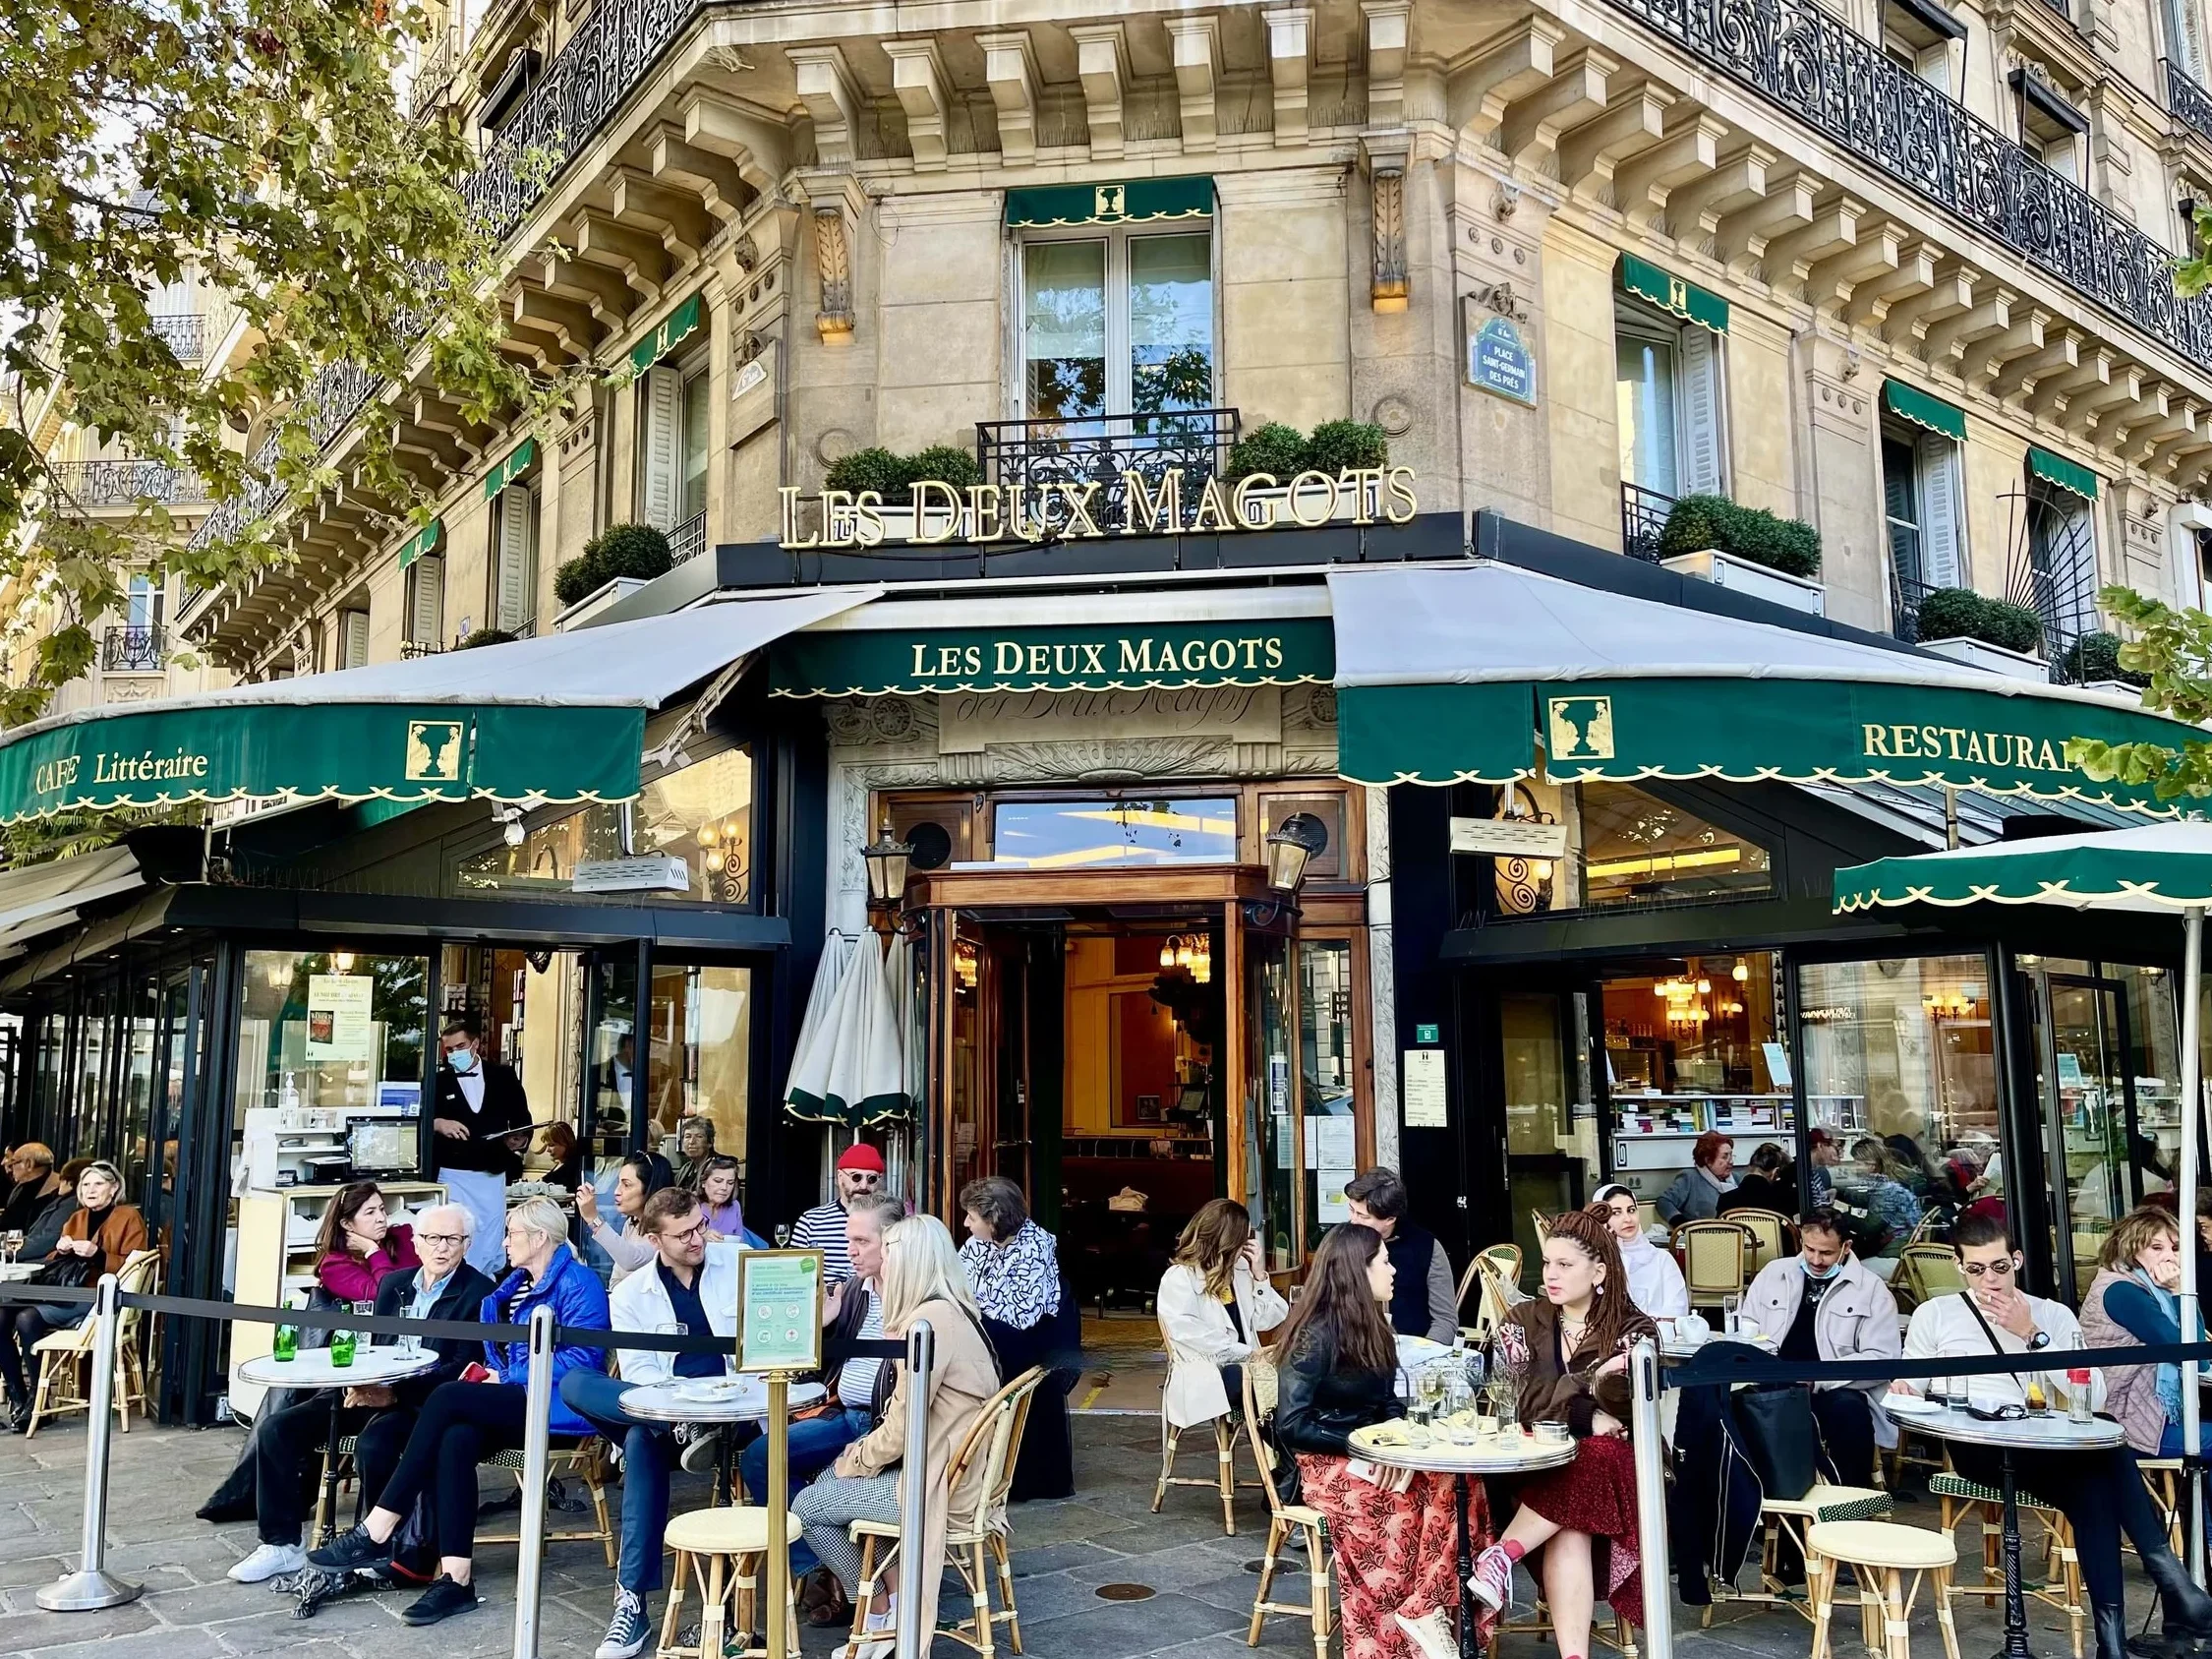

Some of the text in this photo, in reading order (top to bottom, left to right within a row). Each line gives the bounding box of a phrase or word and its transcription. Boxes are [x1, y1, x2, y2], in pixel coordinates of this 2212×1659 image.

[1482, 354, 1526, 379] SAINT-GERMAIN
[1493, 345, 1514, 362] PLACE
[1488, 370, 1502, 384] DES
[778, 463, 1419, 549] LES DEUX MAGOTS
[909, 637, 1284, 678] LES DEUX MAGOTS
[35, 746, 208, 795] CAFE Littéraire
